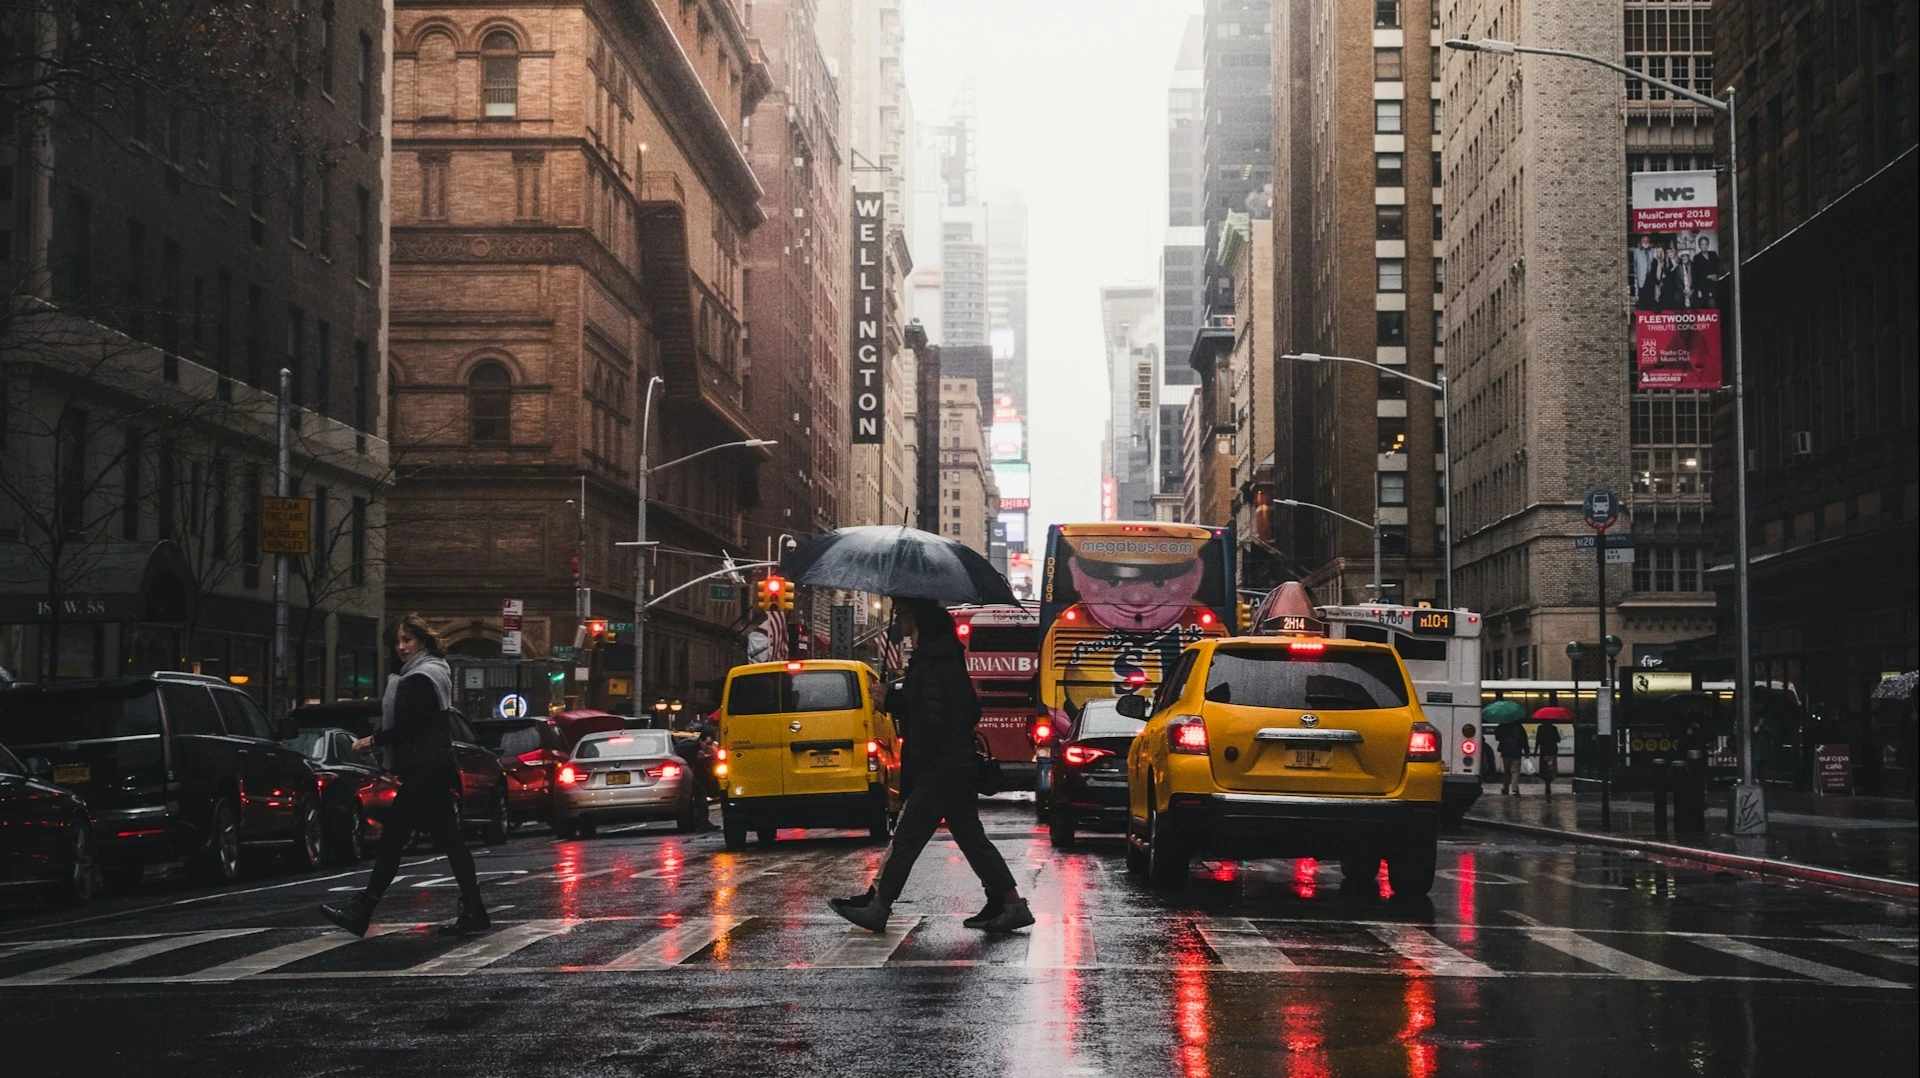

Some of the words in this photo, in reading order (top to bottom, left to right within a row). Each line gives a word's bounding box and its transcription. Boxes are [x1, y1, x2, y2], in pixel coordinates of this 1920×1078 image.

[1655, 187, 1695, 201] NYC
[1638, 212, 1684, 220] MusiCares
[1686, 210, 1711, 219] 2018
[1637, 221, 1667, 230] Person
[1668, 221, 1679, 229] of
[1694, 219, 1714, 228] Year
[855, 199, 881, 436] WELLINGTON
[1638, 315, 1696, 324] FLEETWOOD
[1697, 314, 1718, 322] MAC
[1677, 323, 1710, 331] CONCERT
[1641, 347, 1657, 356] 26
[1577, 537, 1594, 547] M20
[1081, 541, 1193, 554] megabus.com
[1046, 557, 1056, 602] DD769
[1284, 617, 1305, 630] 2H14
[1379, 614, 1403, 624] 6700
